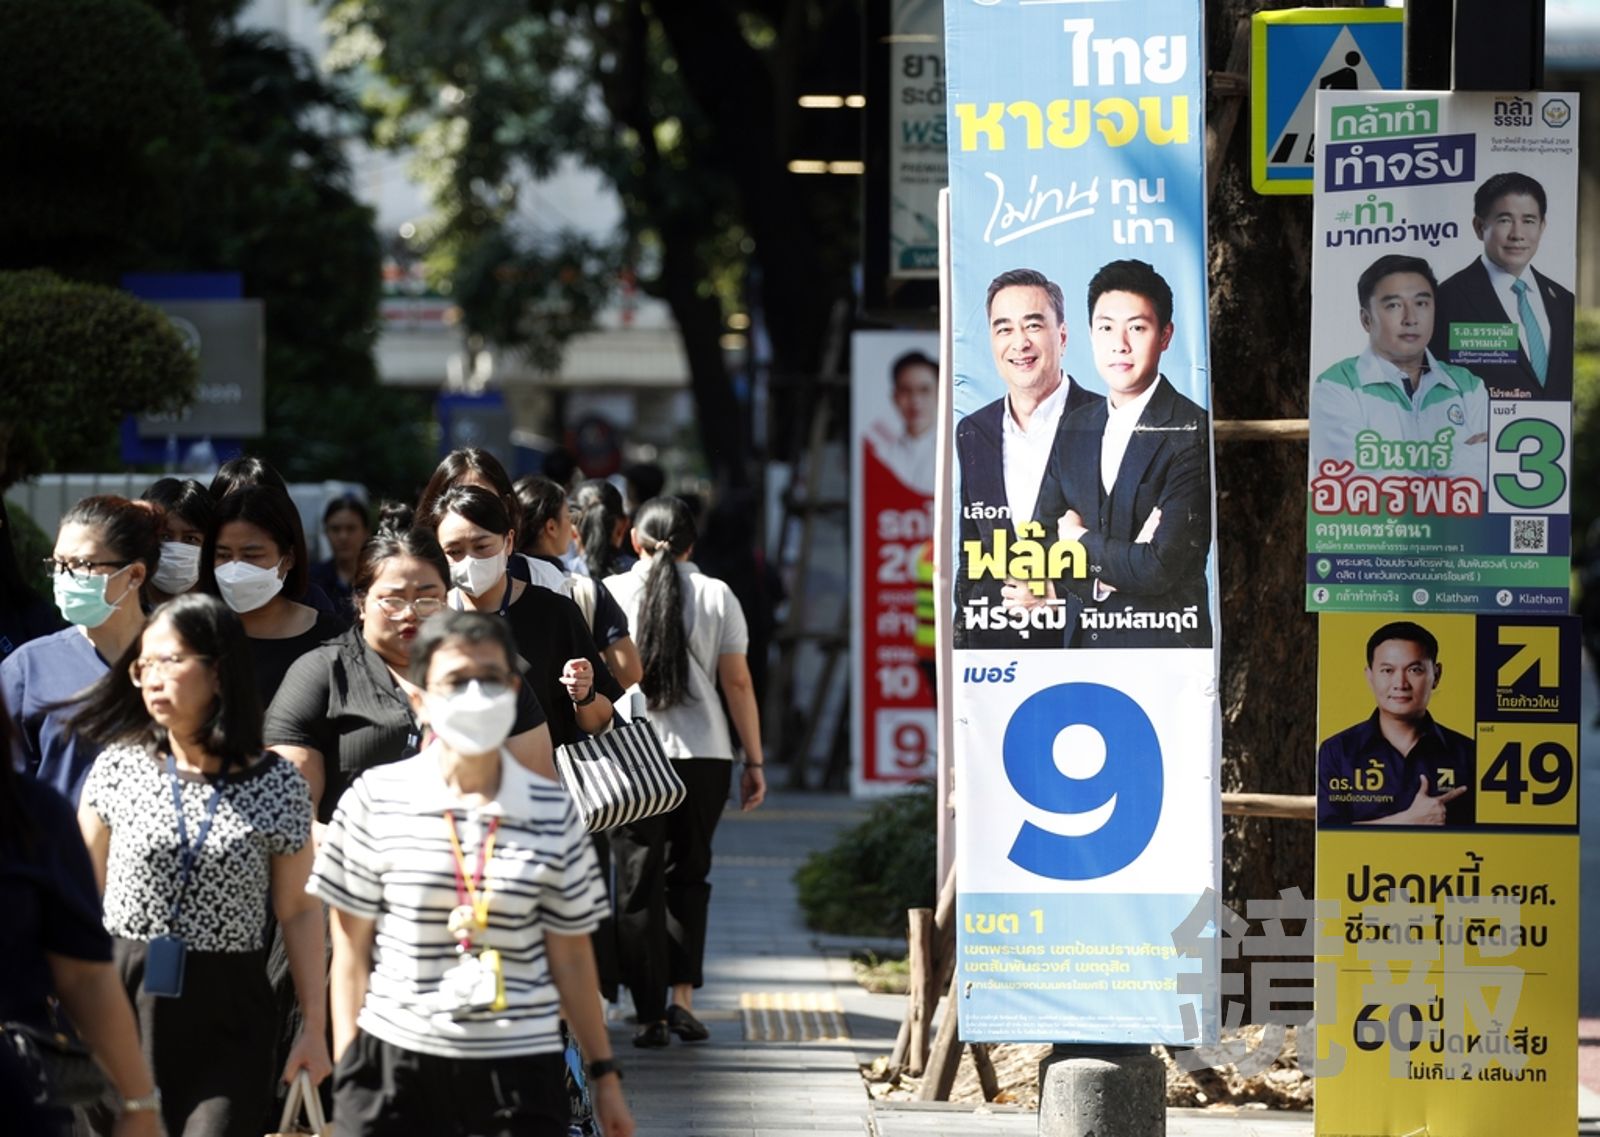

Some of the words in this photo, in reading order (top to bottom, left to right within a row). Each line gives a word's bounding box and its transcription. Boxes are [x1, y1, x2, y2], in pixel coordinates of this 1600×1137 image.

[903, 54, 946, 79] ยา
[1063, 18, 1187, 87] ไทย
[1337, 102, 1431, 136] กล้าทำ
[1494, 96, 1533, 116] กล้า
[1494, 115, 1533, 127] ธรรม
[955, 95, 1189, 152] หายจน
[1334, 142, 1464, 185] ทำจริง
[984, 172, 1099, 243] ไม่ทน
[1110, 177, 1165, 215] ทุน
[1112, 217, 1174, 244] เทา
[1325, 218, 1459, 248] มากกว่าพูด
[1489, 387, 1532, 399] โปรดเลือก
[1493, 403, 1516, 415] เบอร์
[1356, 428, 1456, 470] อินทร์
[1493, 417, 1567, 510] 3
[1311, 459, 1483, 516] อัครพล
[963, 501, 1011, 519] เลือก
[1315, 519, 1431, 541] คฤหเดชรัตนา
[963, 520, 1087, 596] ฟลุ๊ค
[1436, 592, 1479, 603] Klatham
[1519, 593, 1563, 604] Klatham
[963, 596, 1067, 639] พีรวุฒิ
[1080, 605, 1198, 633] พิมพ์สมฤดี
[963, 661, 1018, 683] เบอร์
[1496, 693, 1559, 708] ไทยก้าวใหม่
[892, 722, 928, 769] 9
[1003, 682, 1165, 881] 9
[1480, 742, 1574, 806] 49
[1346, 852, 1482, 904] ปลดหนี้
[1491, 884, 1557, 906] กยศ.
[964, 911, 1019, 934] เขต
[1030, 909, 1044, 934] 1
[1353, 1003, 1423, 1052] 60
[1461, 1063, 1473, 1080] 2
